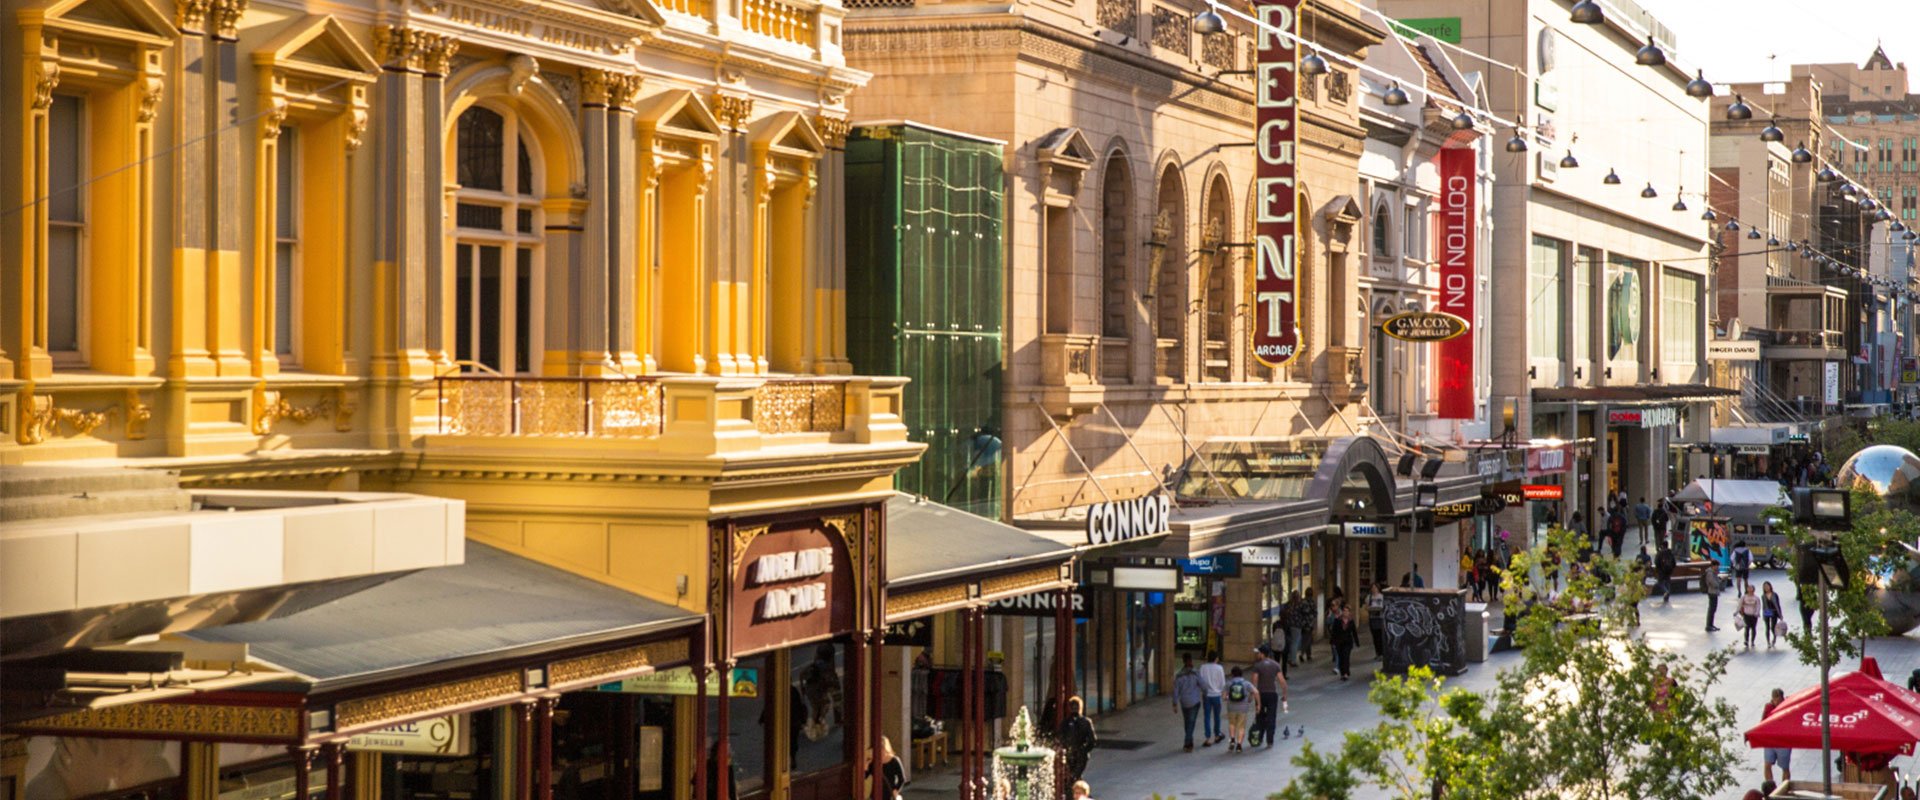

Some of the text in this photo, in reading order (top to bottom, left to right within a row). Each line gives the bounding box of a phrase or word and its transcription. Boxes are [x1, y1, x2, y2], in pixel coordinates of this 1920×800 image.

[1257, 5, 1294, 337] REGENT
[1446, 176, 1467, 307] COTTON ON
[1411, 329, 1451, 337] JEWELLER
[1256, 345, 1293, 356] ARCADE
[1452, 503, 1473, 513] CUT
[1088, 494, 1170, 546] CONNOR
[1352, 525, 1387, 535] SHIELS
[754, 546, 834, 584] ADELAIDE
[763, 582, 826, 619] ARCADE
[1802, 712, 1857, 724] CIBO
[365, 736, 405, 747] JEWELLER
